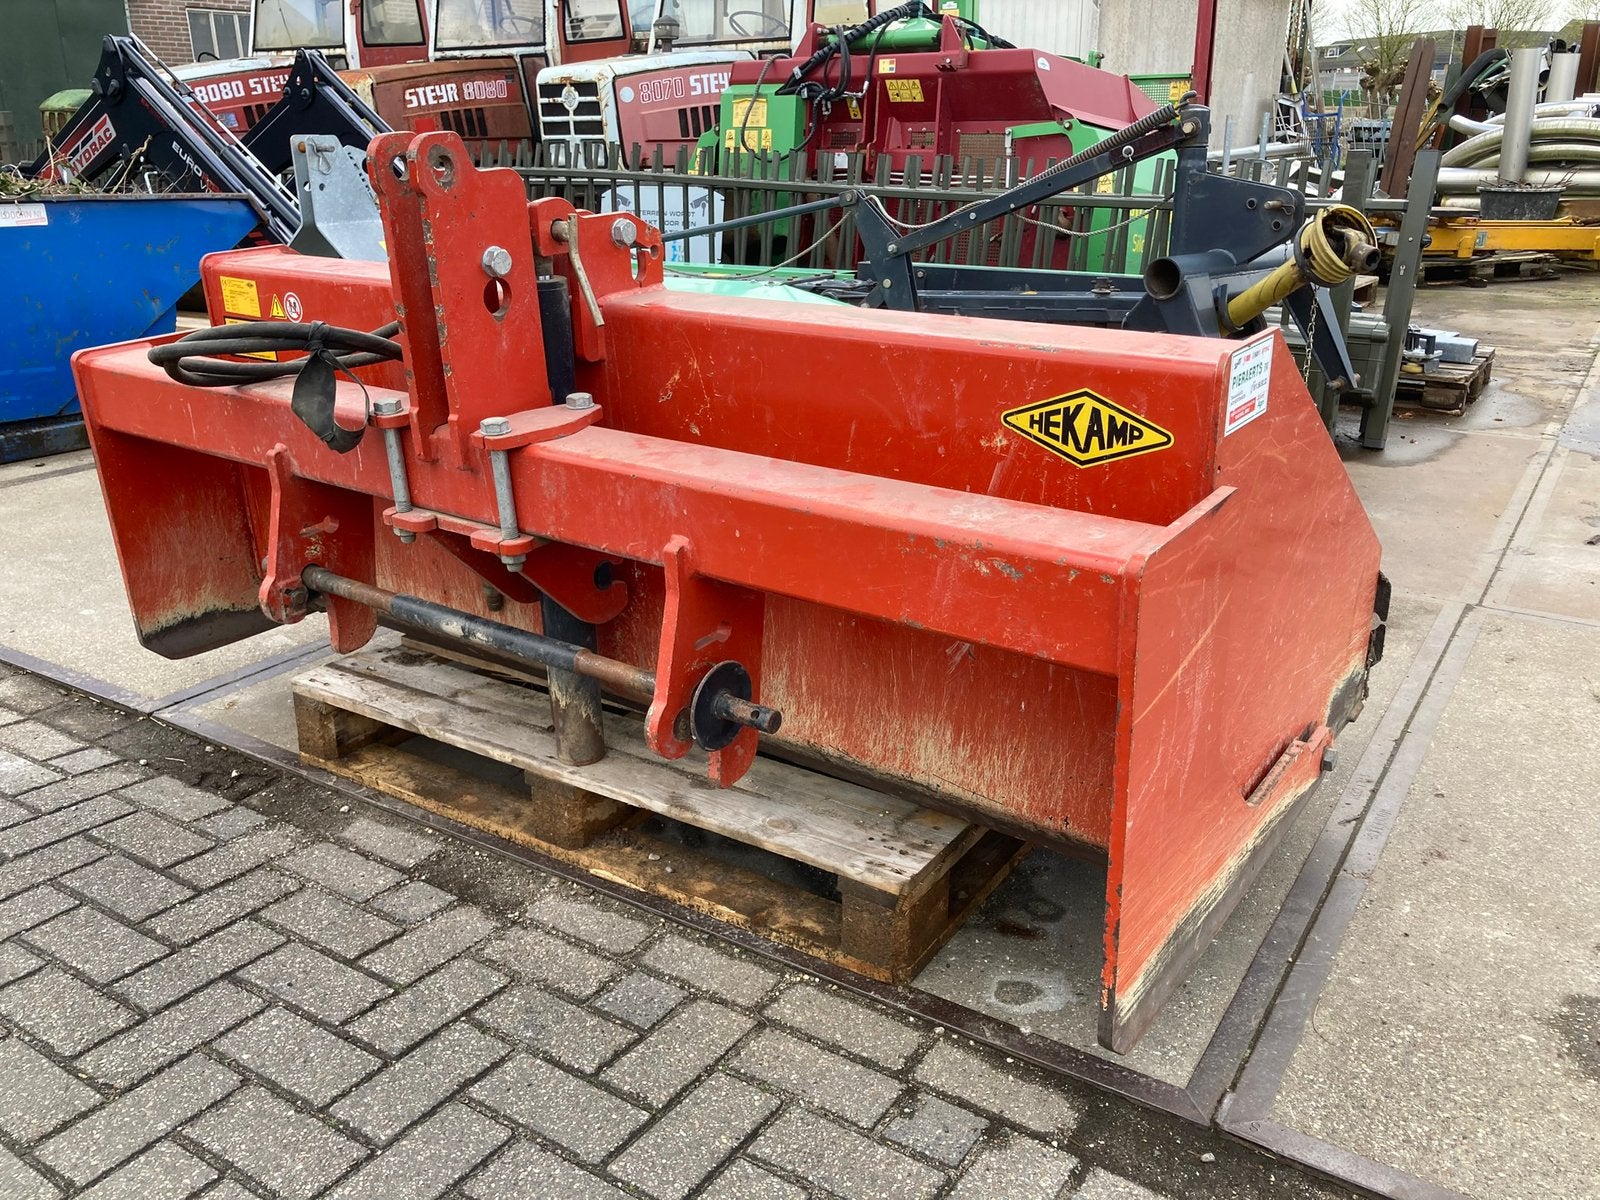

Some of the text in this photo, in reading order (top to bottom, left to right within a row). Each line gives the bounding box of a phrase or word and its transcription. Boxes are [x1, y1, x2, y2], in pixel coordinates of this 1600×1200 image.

[194, 80, 245, 103] 8080
[405, 80, 507, 108] STEYR 8080
[639, 72, 731, 103] 8070 STEY
[71, 126, 113, 177] HYDRAC
[172, 141, 203, 178] EURO
[1029, 402, 1144, 454] HEKAMP
